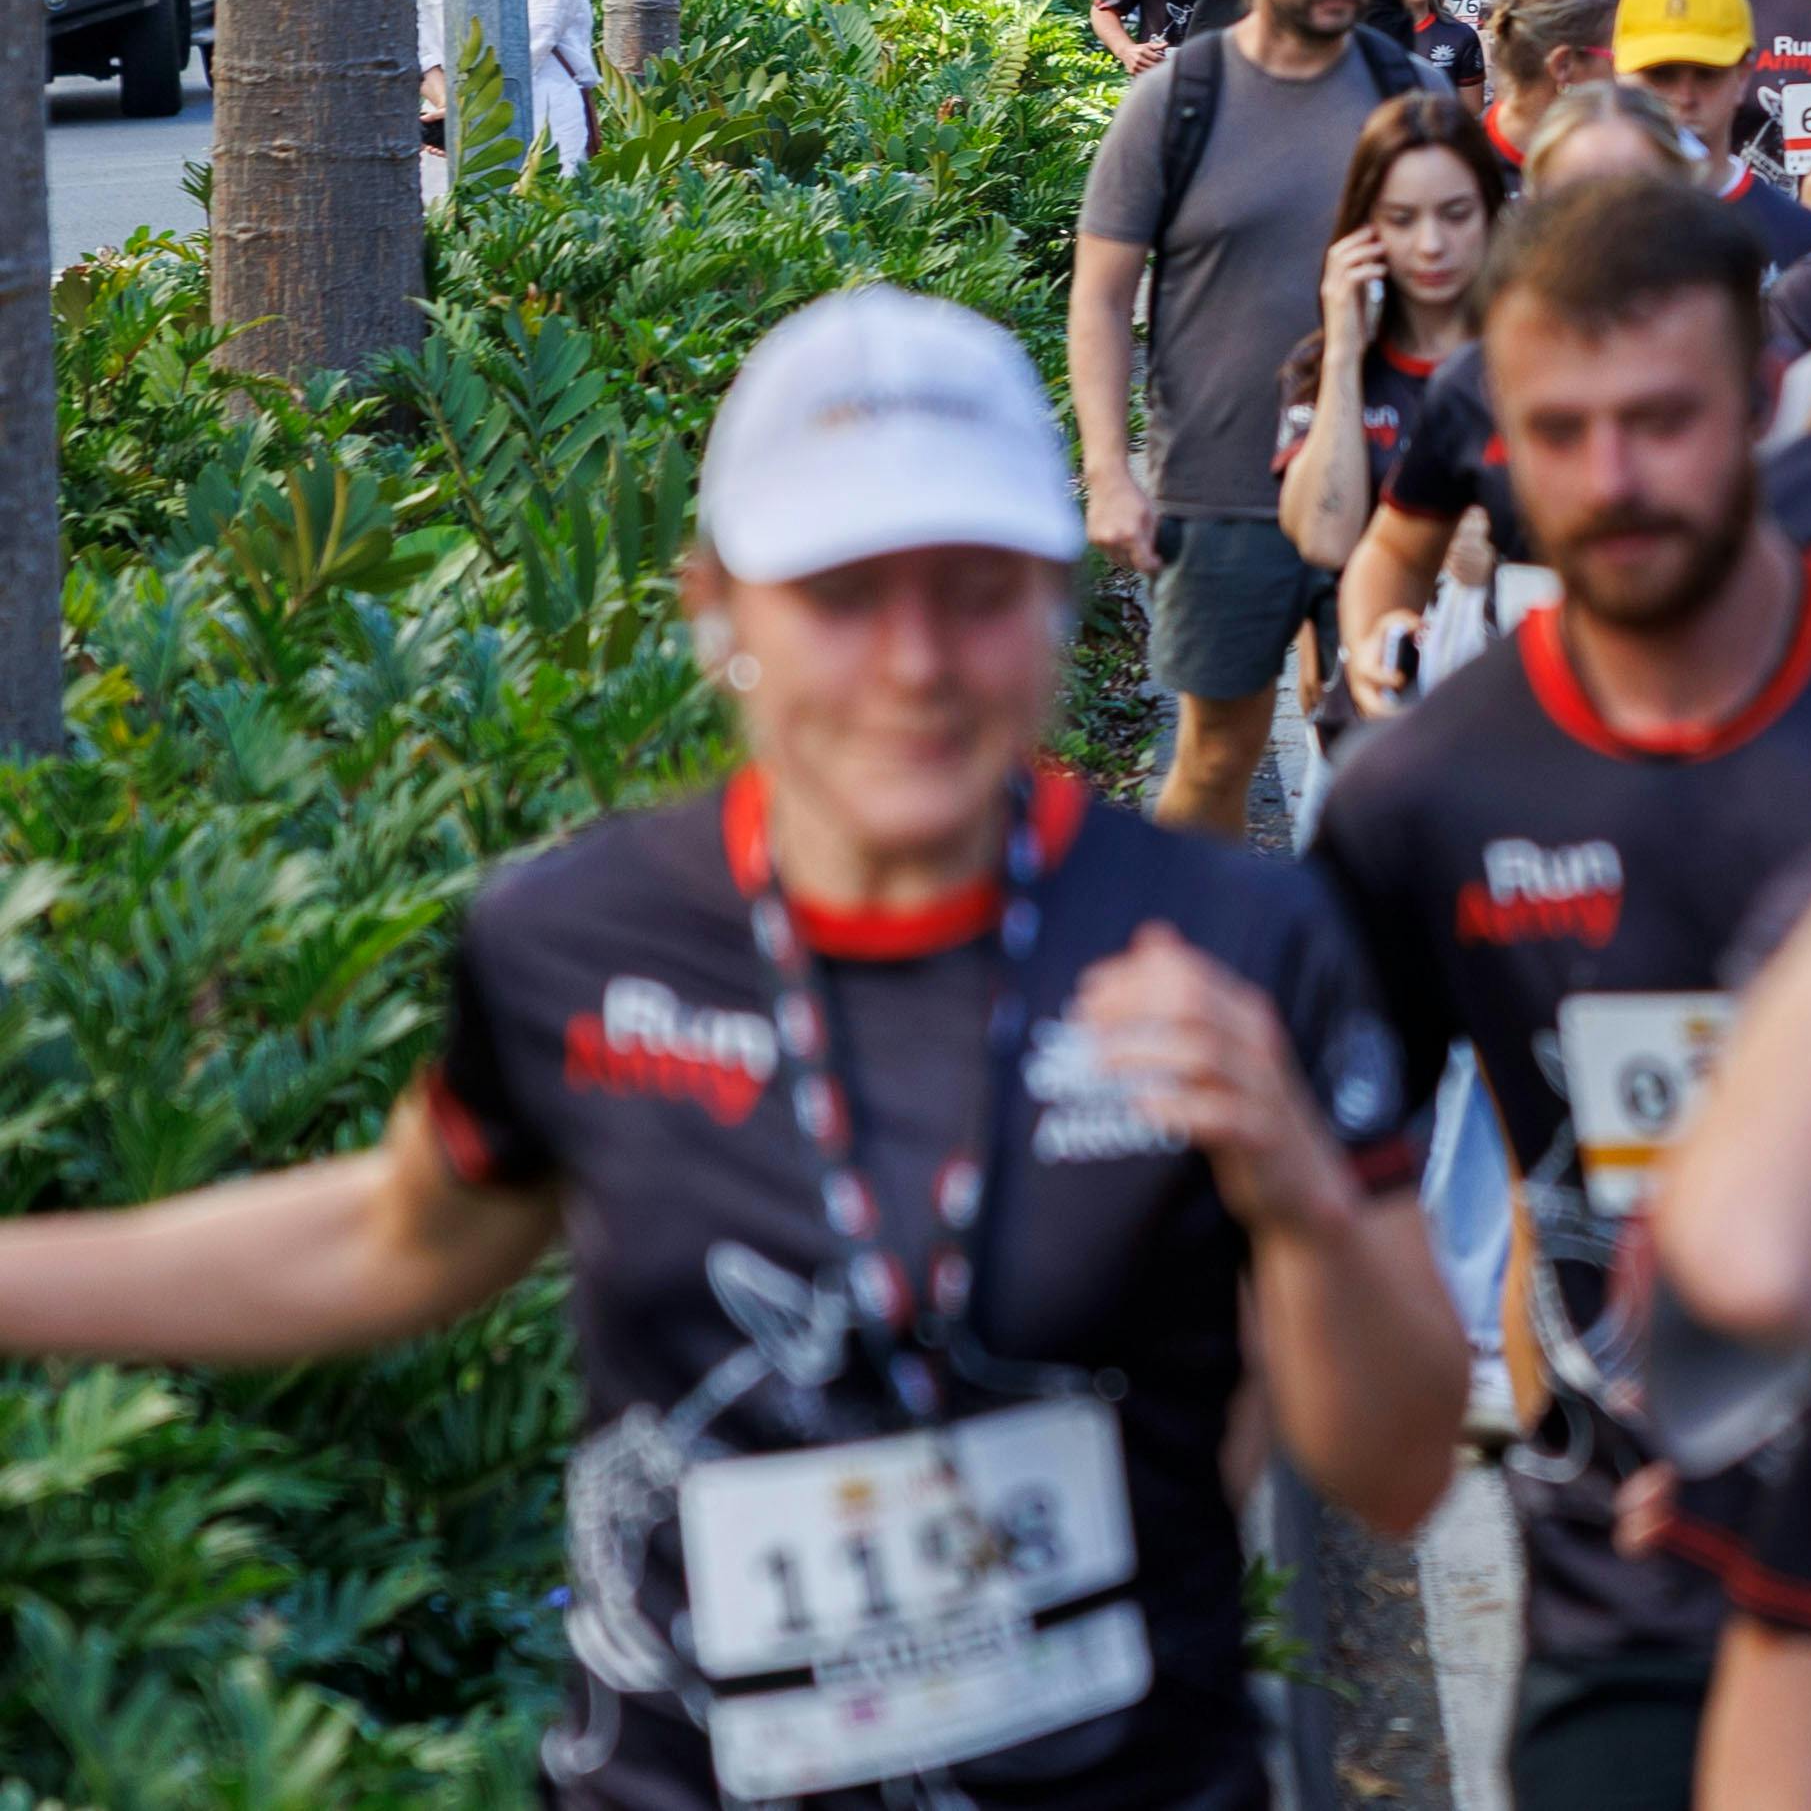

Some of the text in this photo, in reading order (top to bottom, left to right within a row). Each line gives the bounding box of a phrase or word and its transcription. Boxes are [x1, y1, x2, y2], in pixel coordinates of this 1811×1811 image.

[1364, 404, 1399, 429] un
[1484, 836, 1624, 907] Run
[603, 975, 778, 1078] Run
